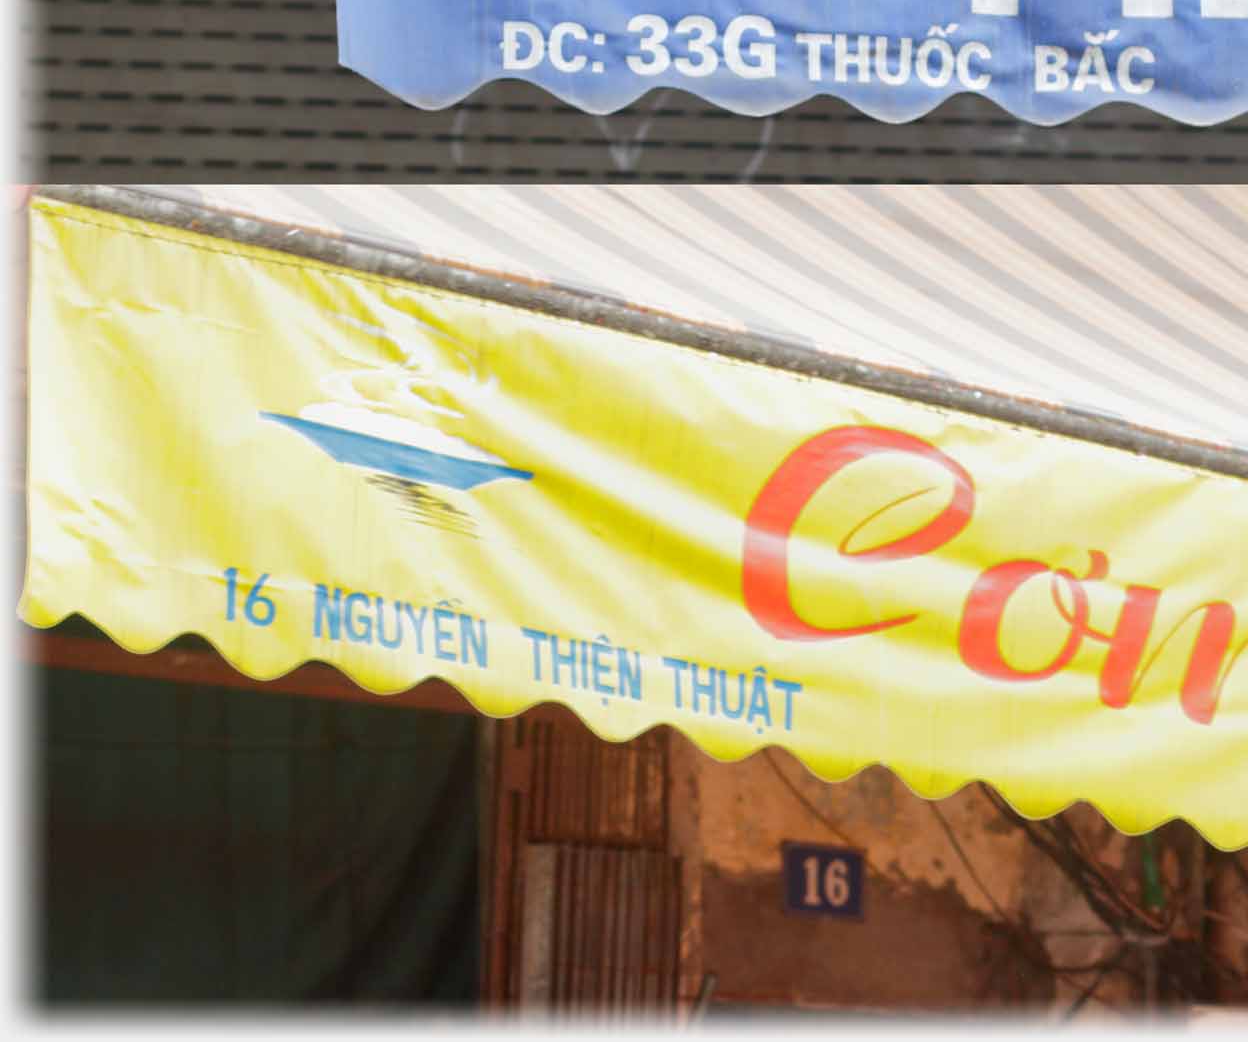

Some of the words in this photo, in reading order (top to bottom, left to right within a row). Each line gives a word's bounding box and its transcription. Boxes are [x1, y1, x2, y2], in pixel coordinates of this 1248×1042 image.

[501, 20, 606, 74] ĐC:
[625, 14, 777, 79] 33G
[795, 23, 993, 91] THUỐC
[1034, 29, 1156, 94] BẮC
[223, 567, 277, 627] 16
[312, 583, 489, 669] NGUYỄN
[520, 625, 643, 707] THIỆN
[660, 656, 803, 735] THUẬT
[800, 856, 850, 908] 16
